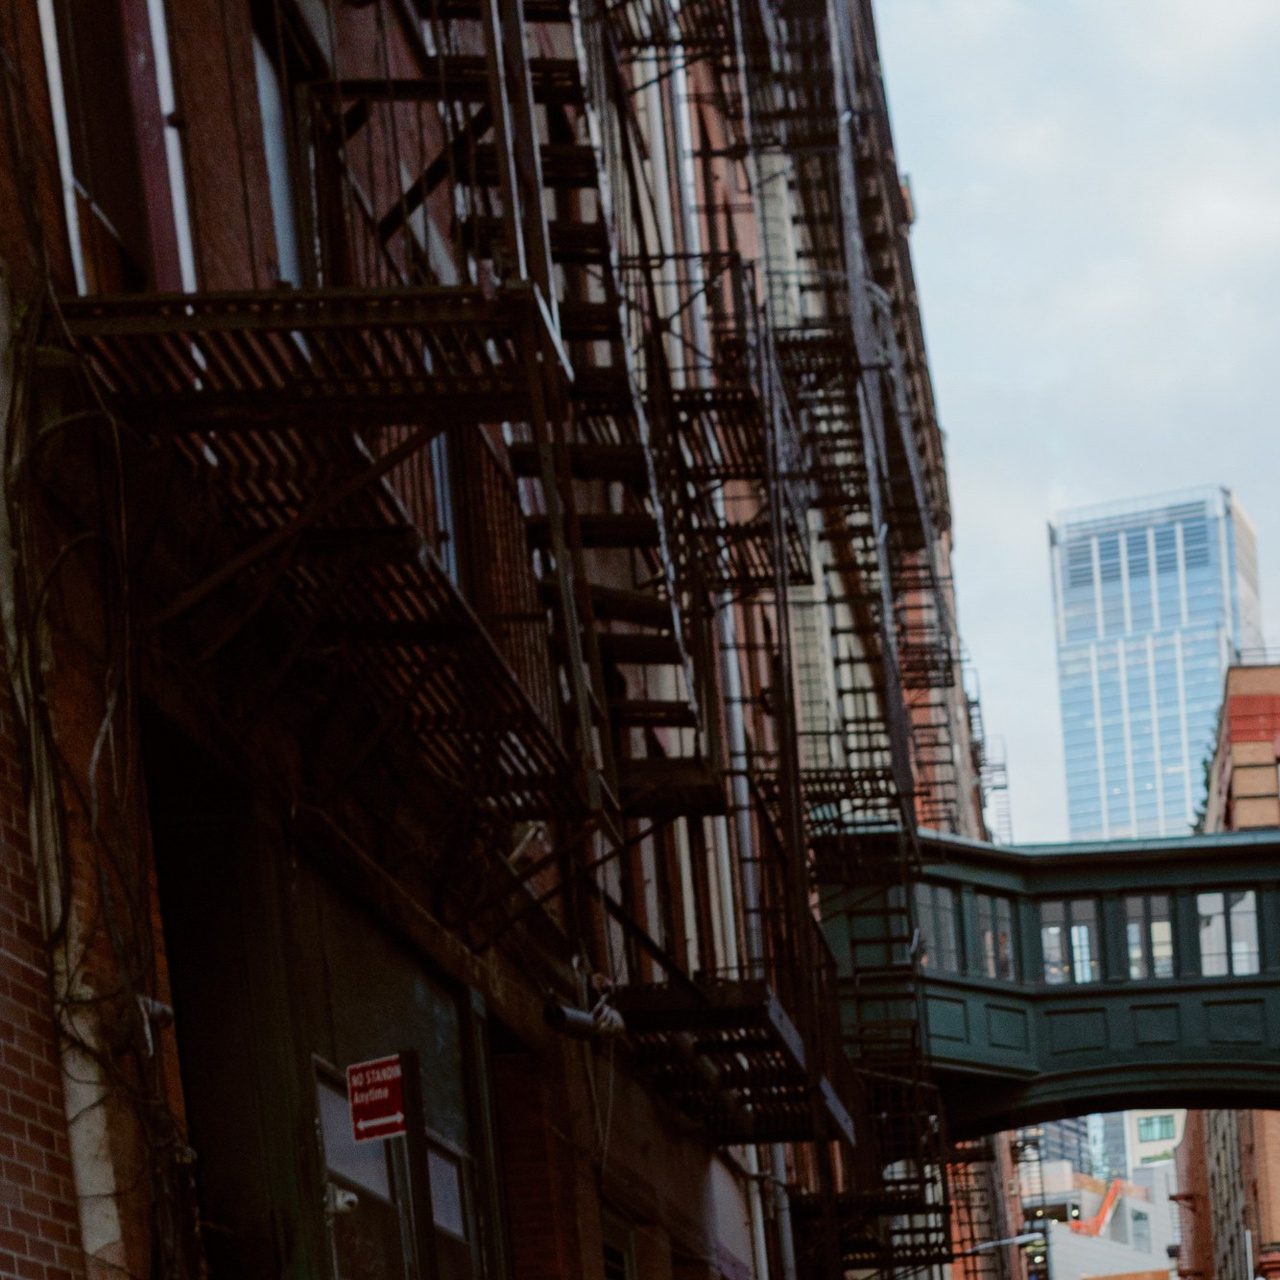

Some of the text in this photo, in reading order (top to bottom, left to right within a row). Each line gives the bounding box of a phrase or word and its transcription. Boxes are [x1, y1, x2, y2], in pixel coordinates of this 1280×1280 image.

[351, 1064, 402, 1087] NO STANDIN
[353, 1087, 389, 1104] Anytime
